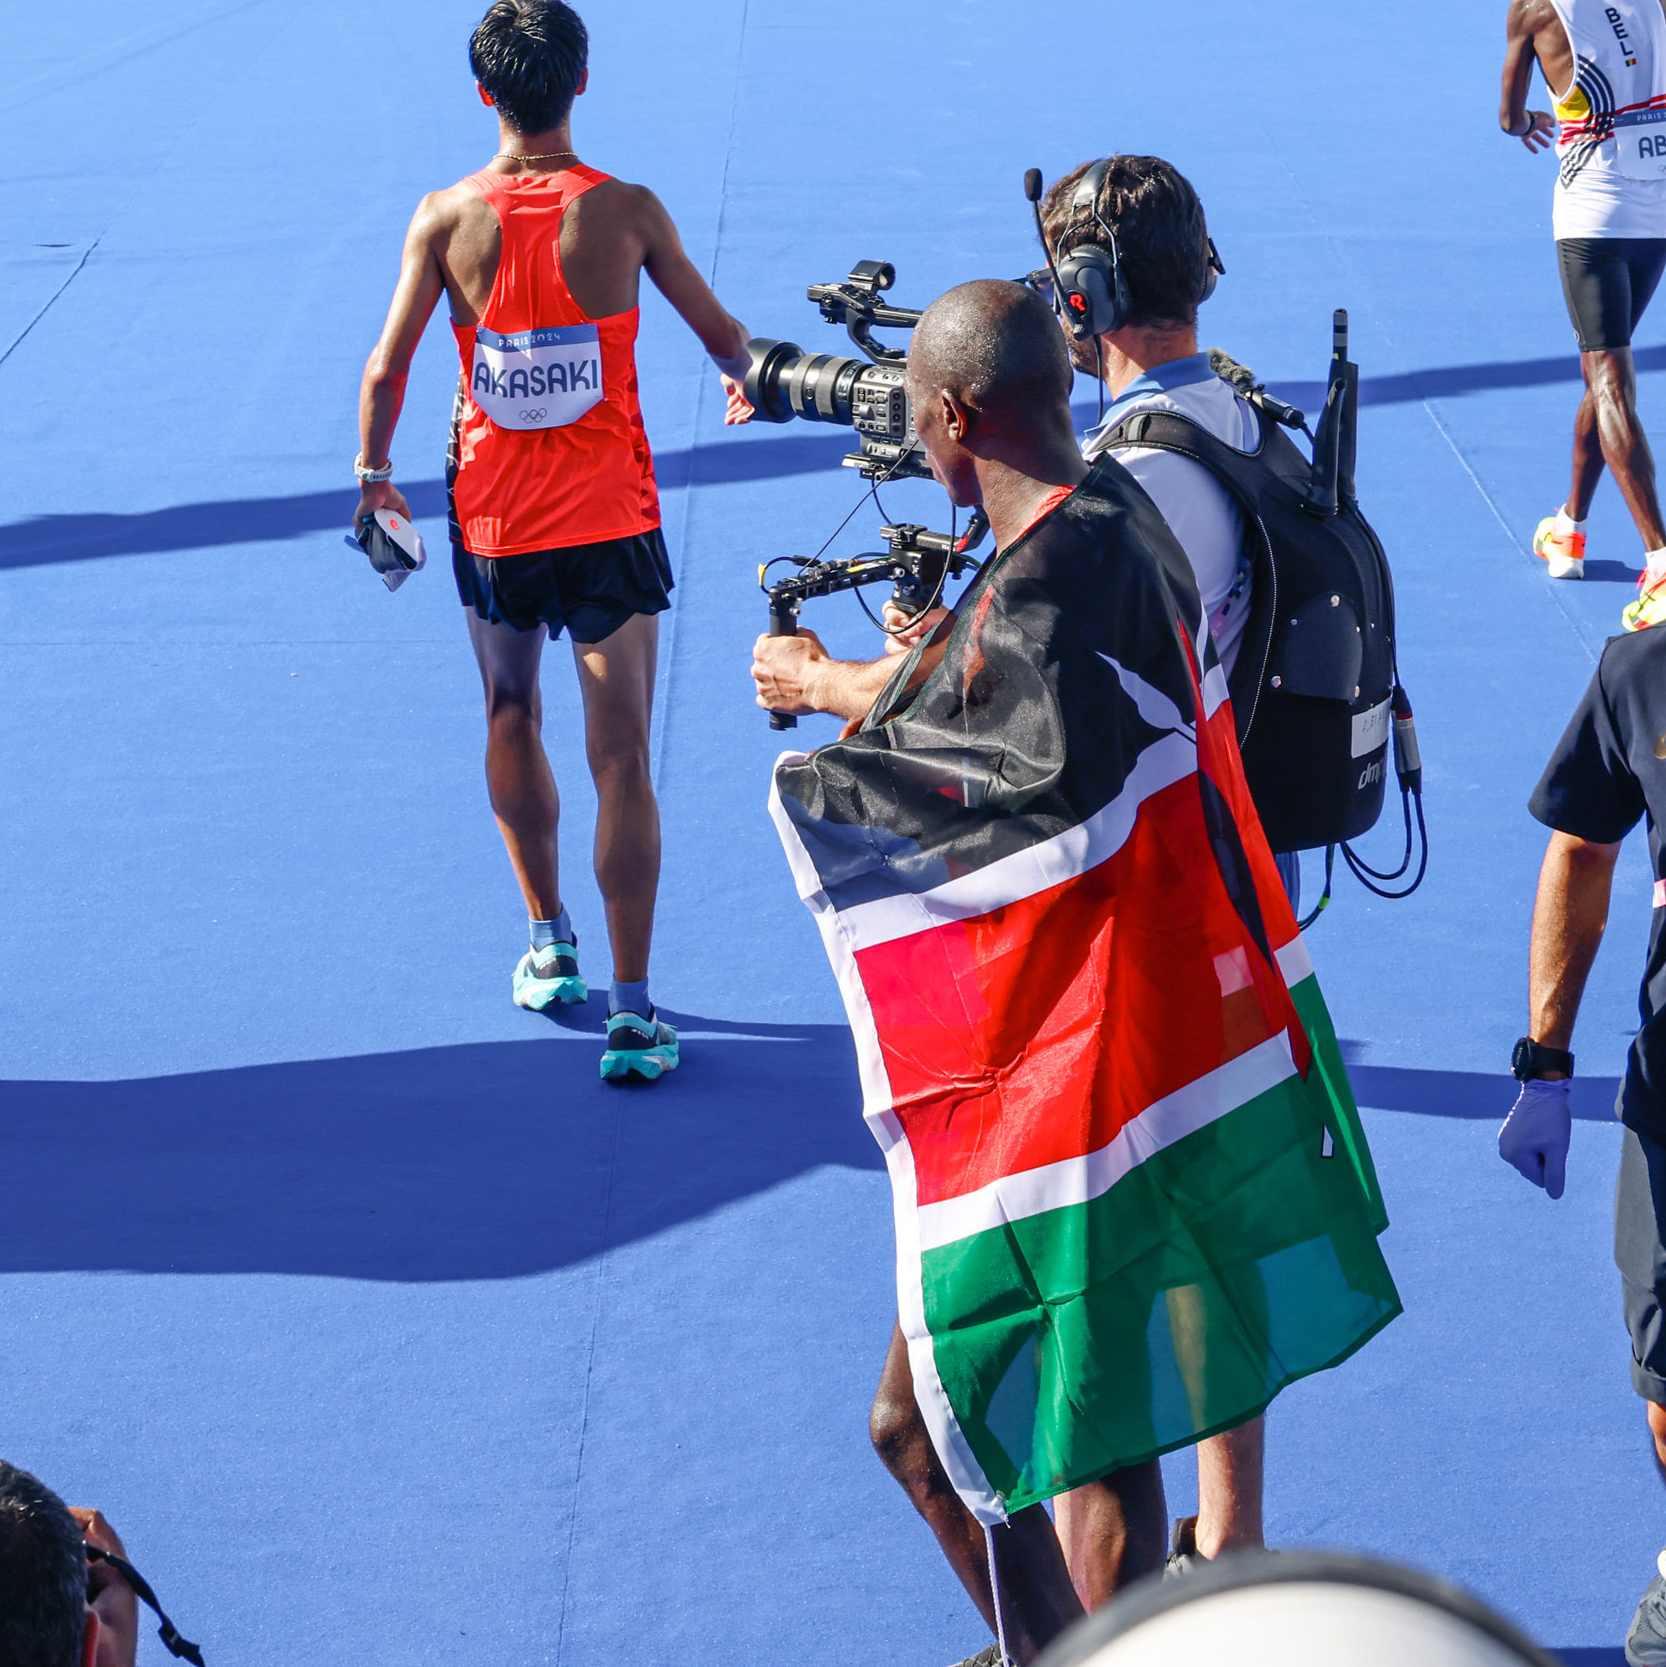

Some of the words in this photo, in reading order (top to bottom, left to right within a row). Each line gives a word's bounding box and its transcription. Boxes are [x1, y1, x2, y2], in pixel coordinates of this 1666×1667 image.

[1605, 7, 1634, 56] BEL
[1636, 112, 1661, 121] PARIS
[498, 336, 529, 347] PARIS
[531, 332, 561, 343] 2024
[473, 359, 599, 398] AKASAKI
